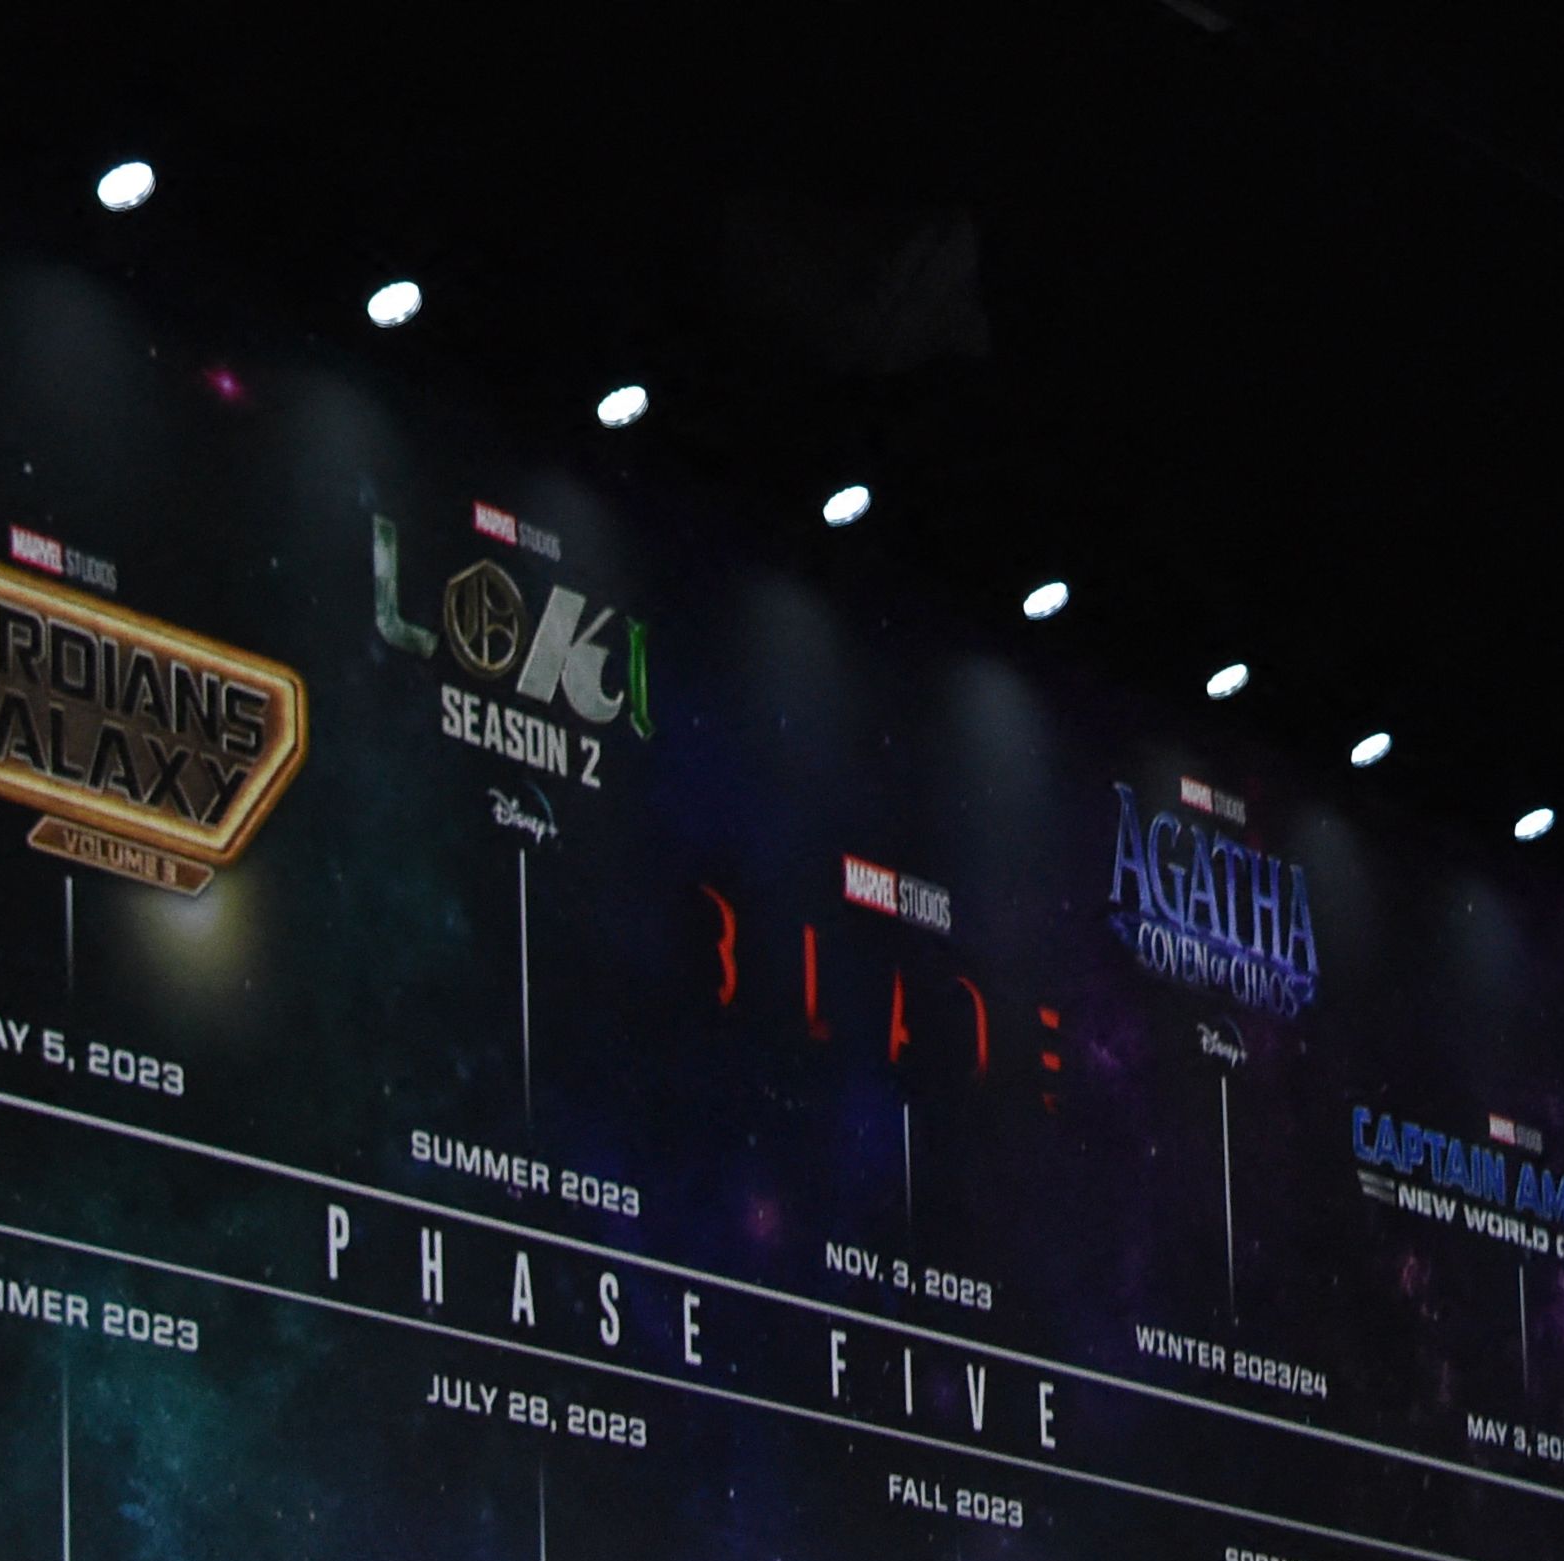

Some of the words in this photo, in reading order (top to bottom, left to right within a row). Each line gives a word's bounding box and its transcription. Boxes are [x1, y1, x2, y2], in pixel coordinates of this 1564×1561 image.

[372, 513, 654, 741] LOKI
[440, 683, 569, 778] SEASON
[580, 735, 602, 789] 2
[63, 829, 158, 878] VOLUME
[1109, 781, 1321, 977] AGATHA
[843, 853, 898, 917] MARVEL
[899, 876, 953, 932] STUDIOS
[1137, 920, 1210, 987] COVEN
[1229, 954, 1301, 1018] CHAOS
[42, 1028, 76, 1073] 5,
[88, 1041, 185, 1097] 2023
[410, 1128, 551, 1195] SUMMER
[560, 1169, 642, 1218] 2023
[1351, 1104, 1508, 1204] CAPTAIN
[1397, 1183, 1458, 1224] NEW
[1462, 1203, 1550, 1254] WORLD
[825, 1240, 884, 1284] NOV.
[892, 1258, 918, 1297] 3,
[924, 1267, 993, 1311] 2023
[102, 1302, 201, 1352] 2023
[326, 1203, 704, 1367] PHASE
[829, 1329, 1057, 1450] FIVE
[1135, 1323, 1227, 1374] WINTER
[1232, 1349, 1329, 1400] 2023/24
[426, 1373, 498, 1416] JULY
[507, 1390, 558, 1434] 28,
[566, 1404, 649, 1449] 2023
[1467, 1412, 1508, 1447] MAY
[888, 1473, 949, 1514] FALL
[955, 1488, 1026, 1530] 2023
